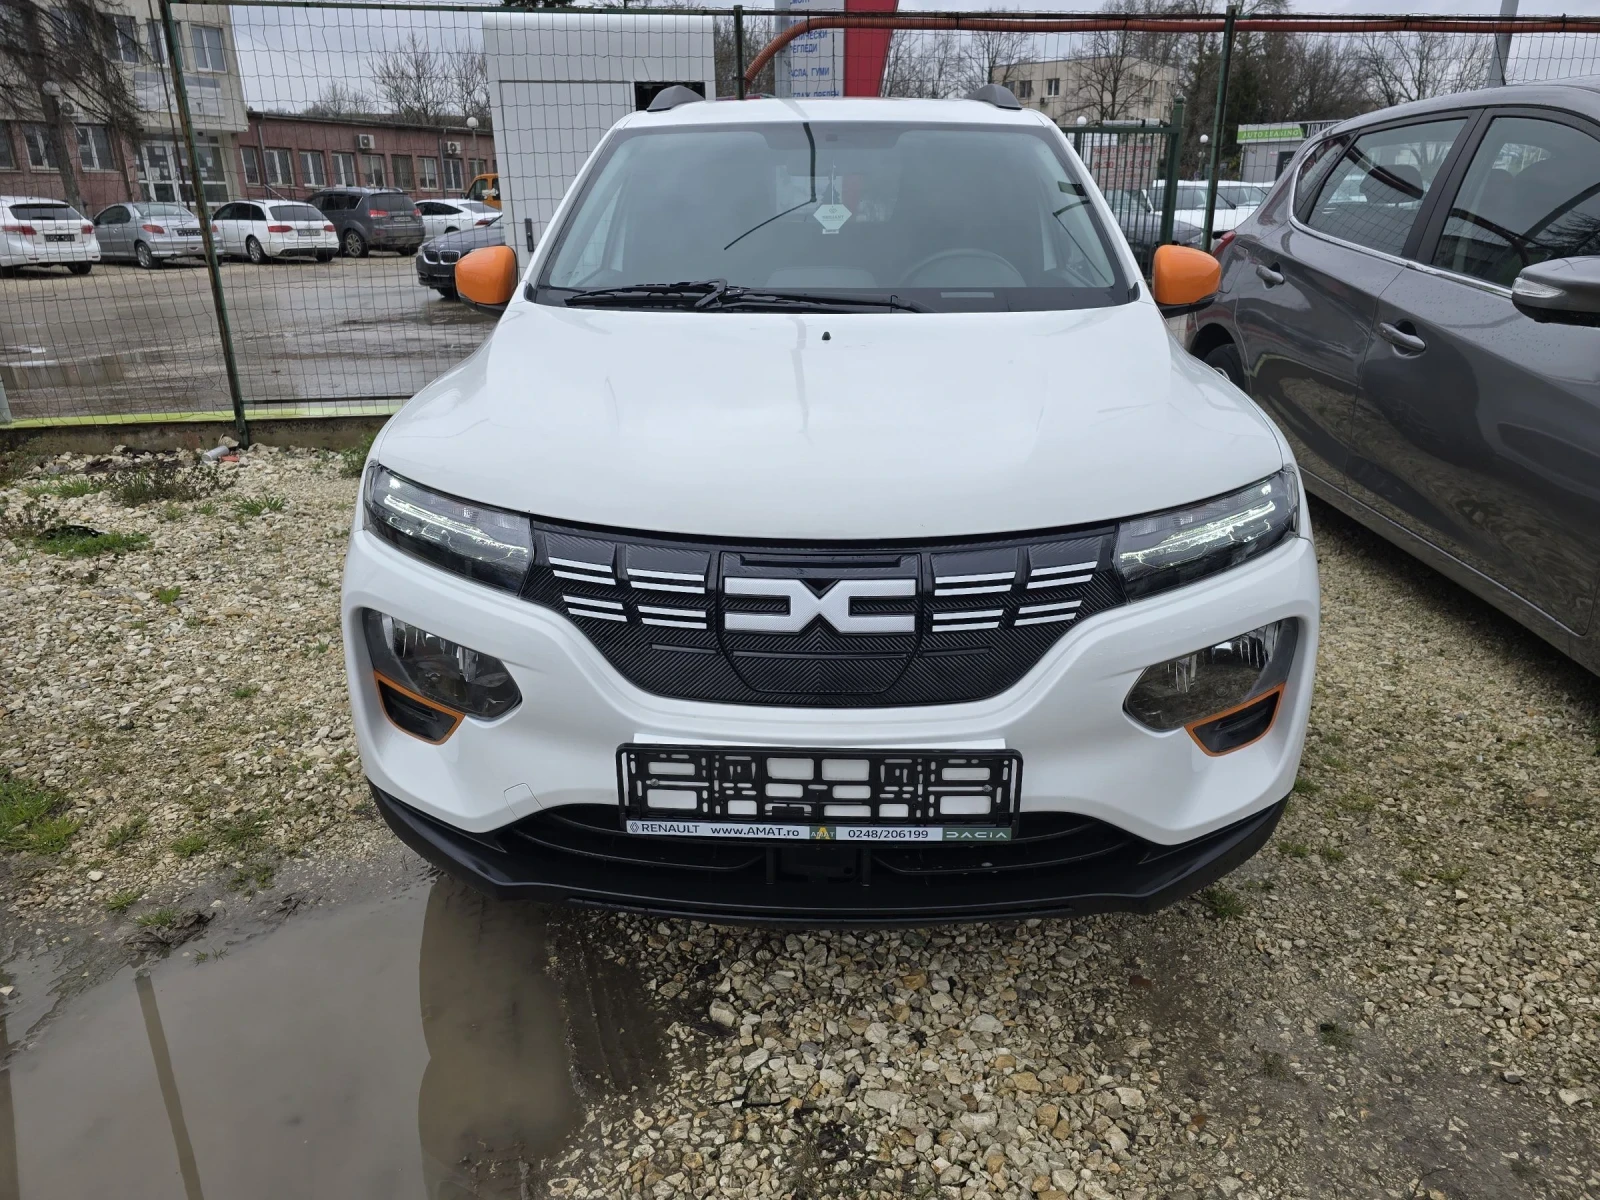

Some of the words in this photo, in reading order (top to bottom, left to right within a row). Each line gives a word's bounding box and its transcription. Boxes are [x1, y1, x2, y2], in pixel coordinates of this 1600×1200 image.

[1265, 129, 1299, 138] LEASING
[641, 823, 700, 834] RENAULT
[710, 826, 800, 837] www.AMAT.ro
[848, 829, 929, 839] 0248/206199
[946, 830, 1007, 839] DACIA
